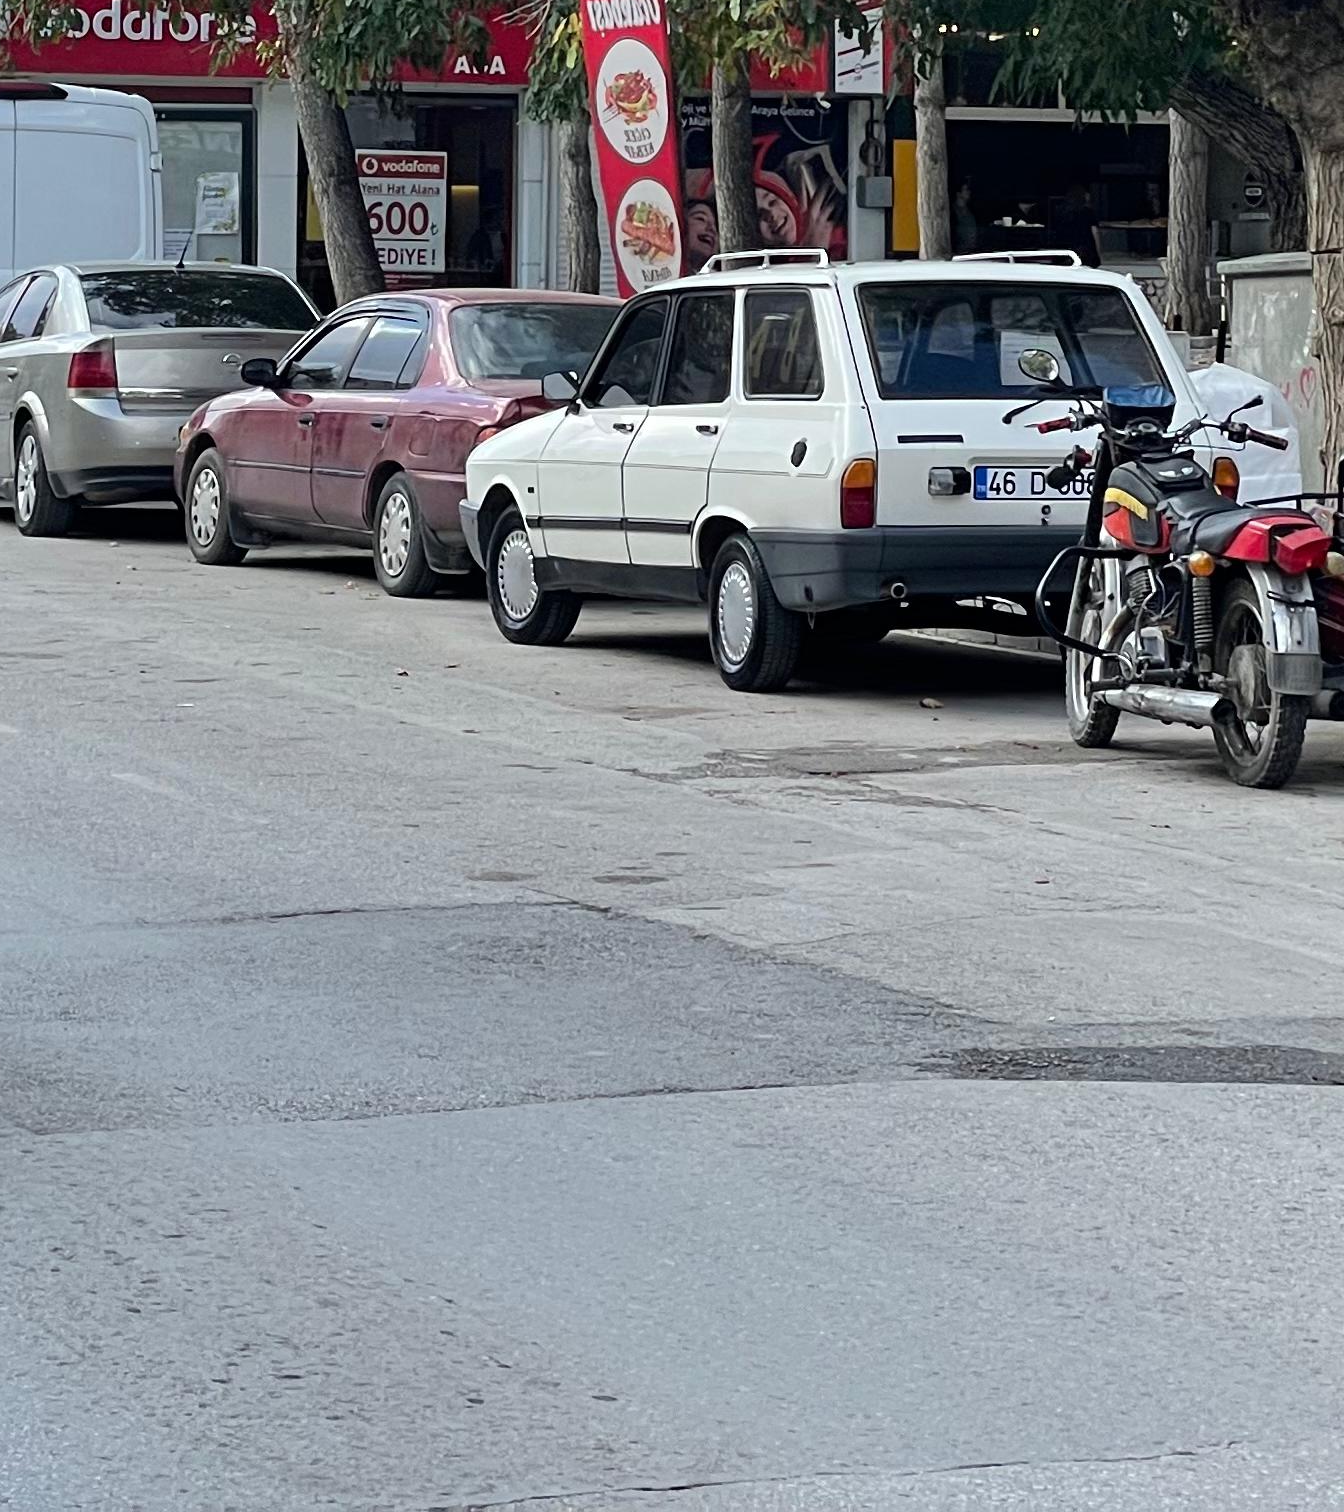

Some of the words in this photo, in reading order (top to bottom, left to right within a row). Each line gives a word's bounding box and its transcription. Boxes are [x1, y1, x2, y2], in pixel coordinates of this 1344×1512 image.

[453, 55, 506, 75] AA
[751, 105, 779, 118] Araya
[382, 160, 440, 173] vodafone
[361, 183, 383, 193] Yeni
[387, 184, 405, 194] Hat
[410, 185, 440, 195] Alana
[367, 201, 429, 235] 600
[989, 471, 1017, 496] 46
[1030, 471, 1047, 496] D
